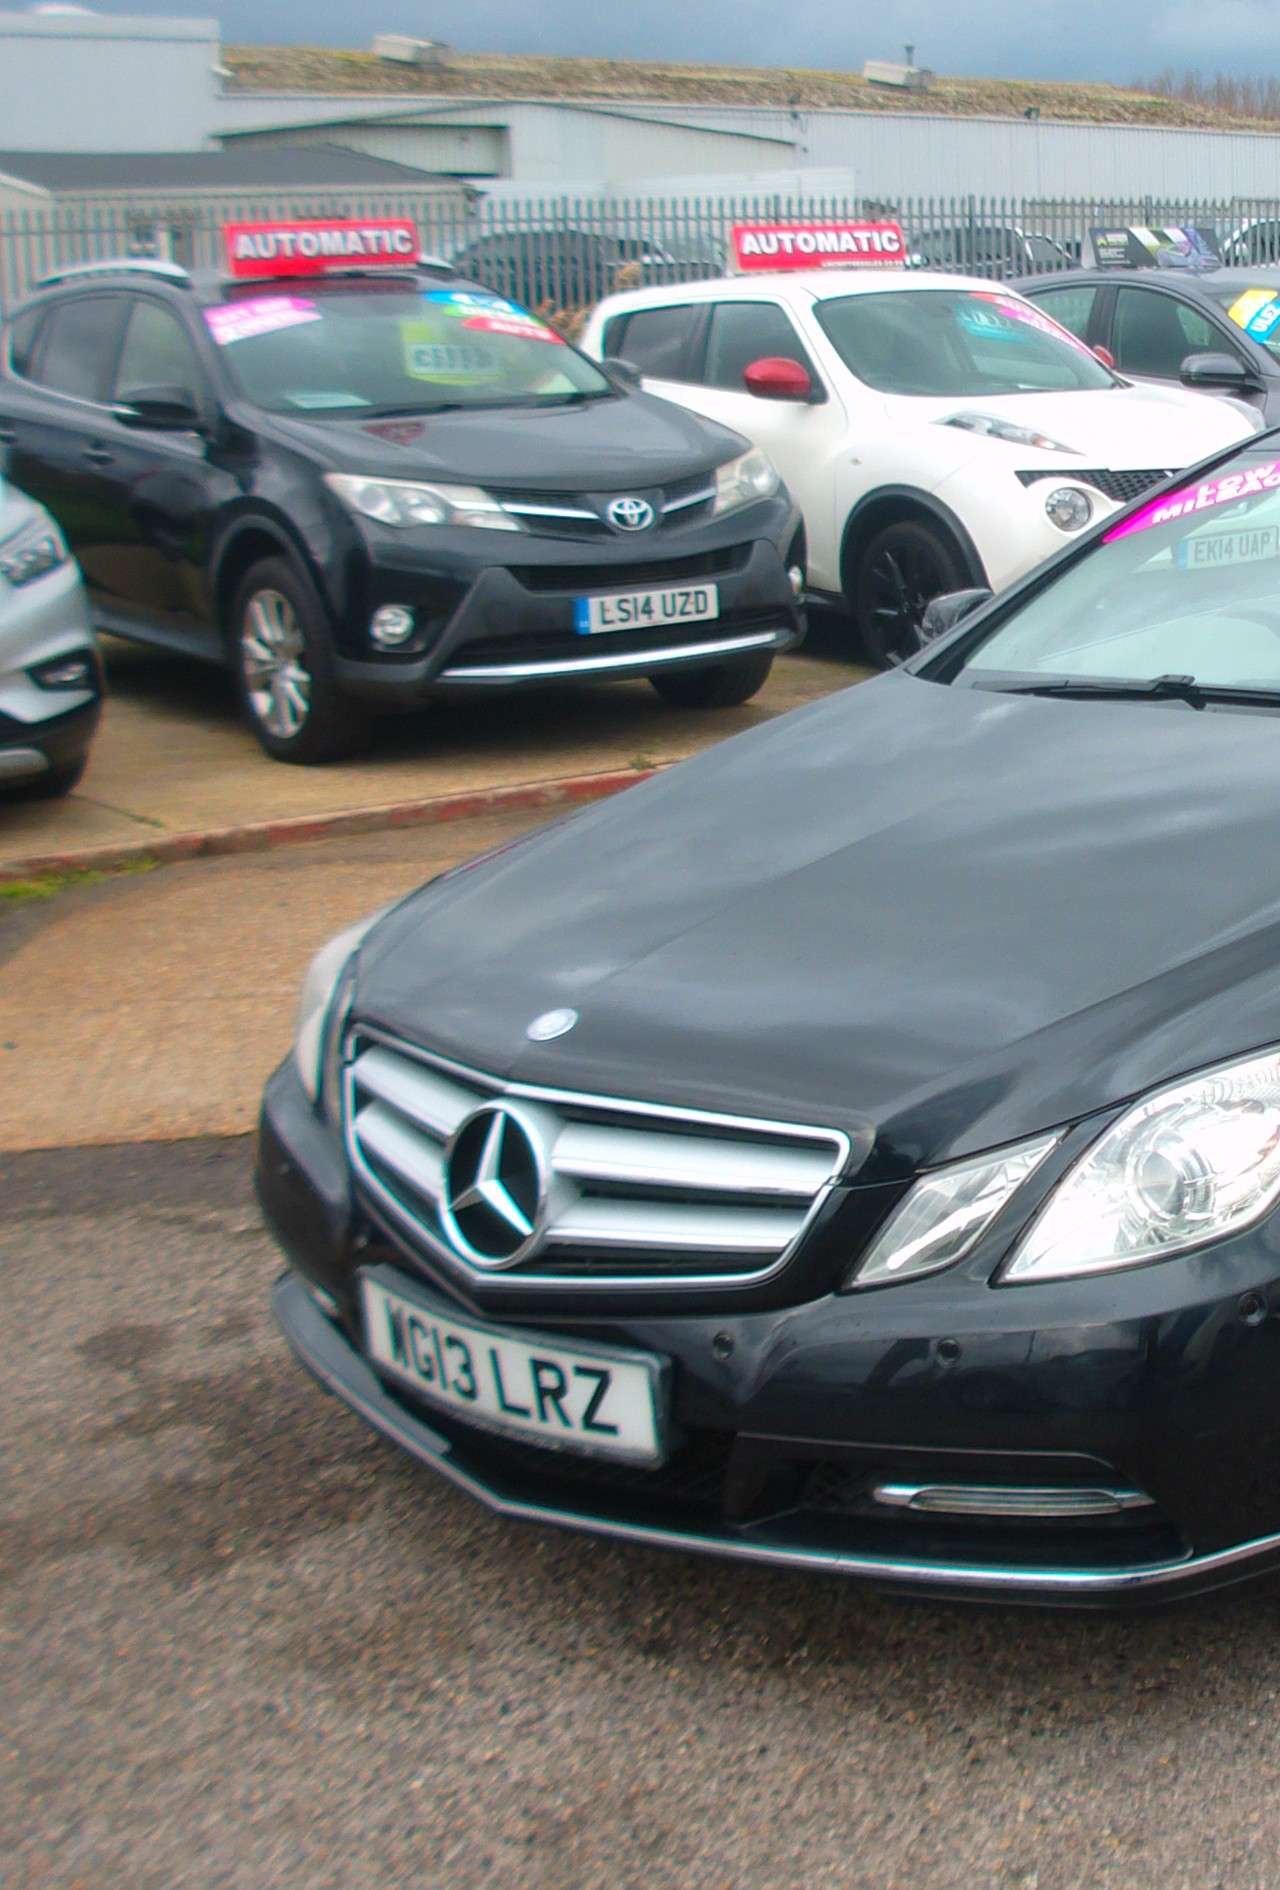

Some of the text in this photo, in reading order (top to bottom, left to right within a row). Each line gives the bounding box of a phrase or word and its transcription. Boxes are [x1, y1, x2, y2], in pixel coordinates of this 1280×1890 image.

[235, 229, 414, 259] AUTOMATIC
[741, 230, 901, 254] AUTOMATIC
[1194, 530, 1271, 562] EK14 UAP
[600, 590, 708, 625] LS14 UZD
[488, 1346, 621, 1437] LRZ
